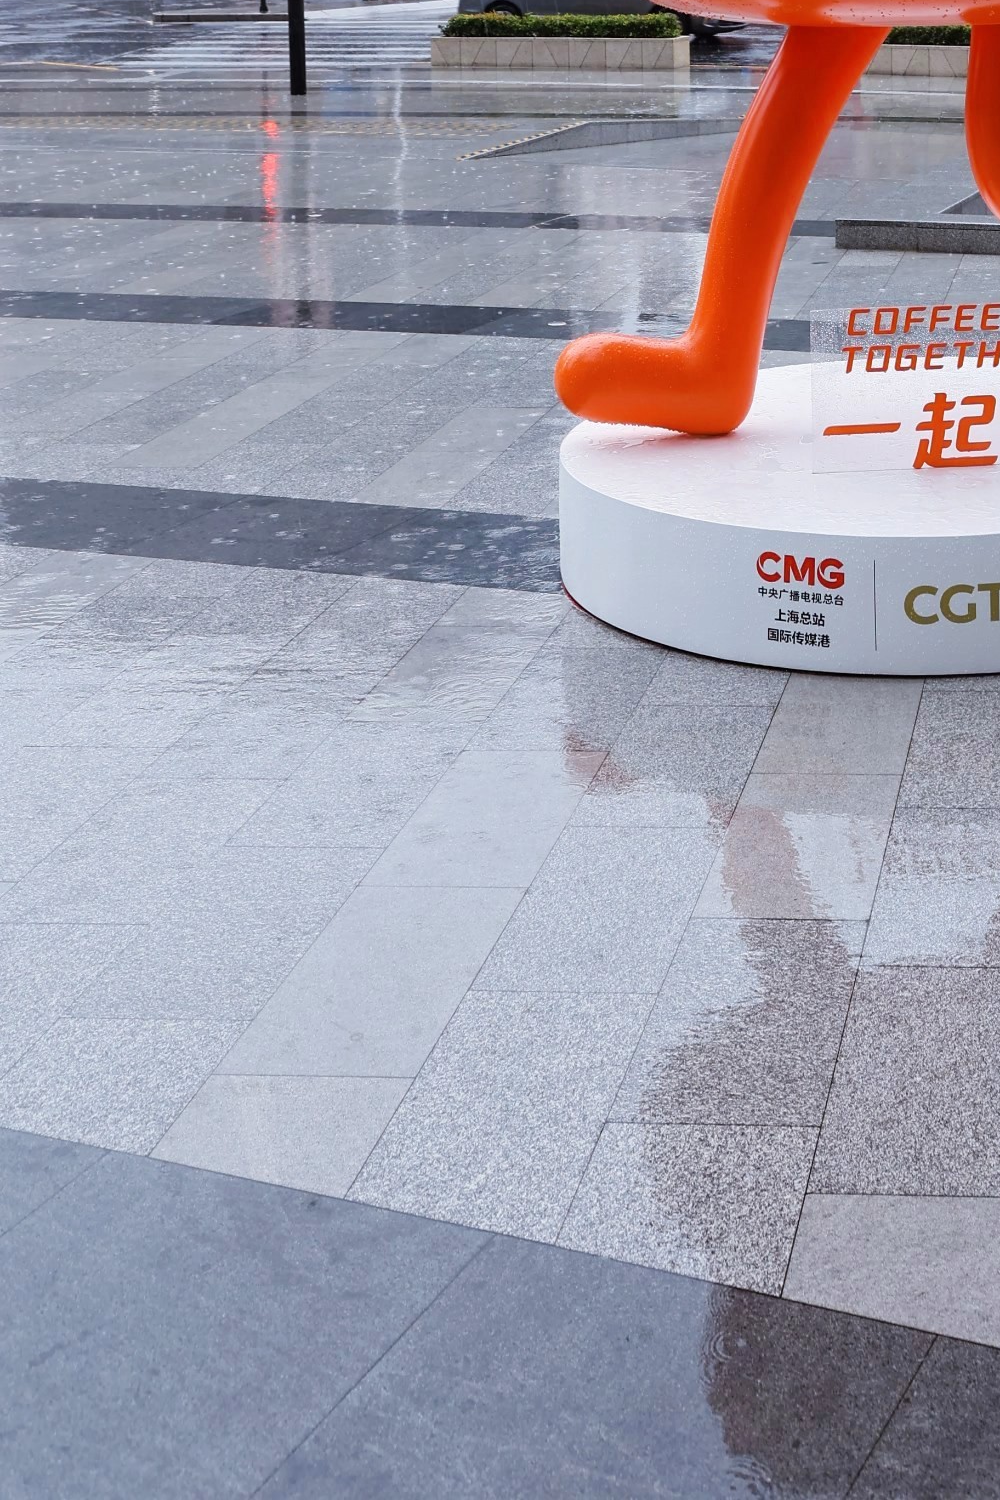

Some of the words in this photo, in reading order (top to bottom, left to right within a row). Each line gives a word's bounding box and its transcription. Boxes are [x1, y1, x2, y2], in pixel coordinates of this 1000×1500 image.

[756, 551, 845, 590] CMG
[757, 586, 845, 606] 中央广播电视总台
[774, 608, 826, 627] 上海总站
[767, 627, 831, 648] 国际传媒港
